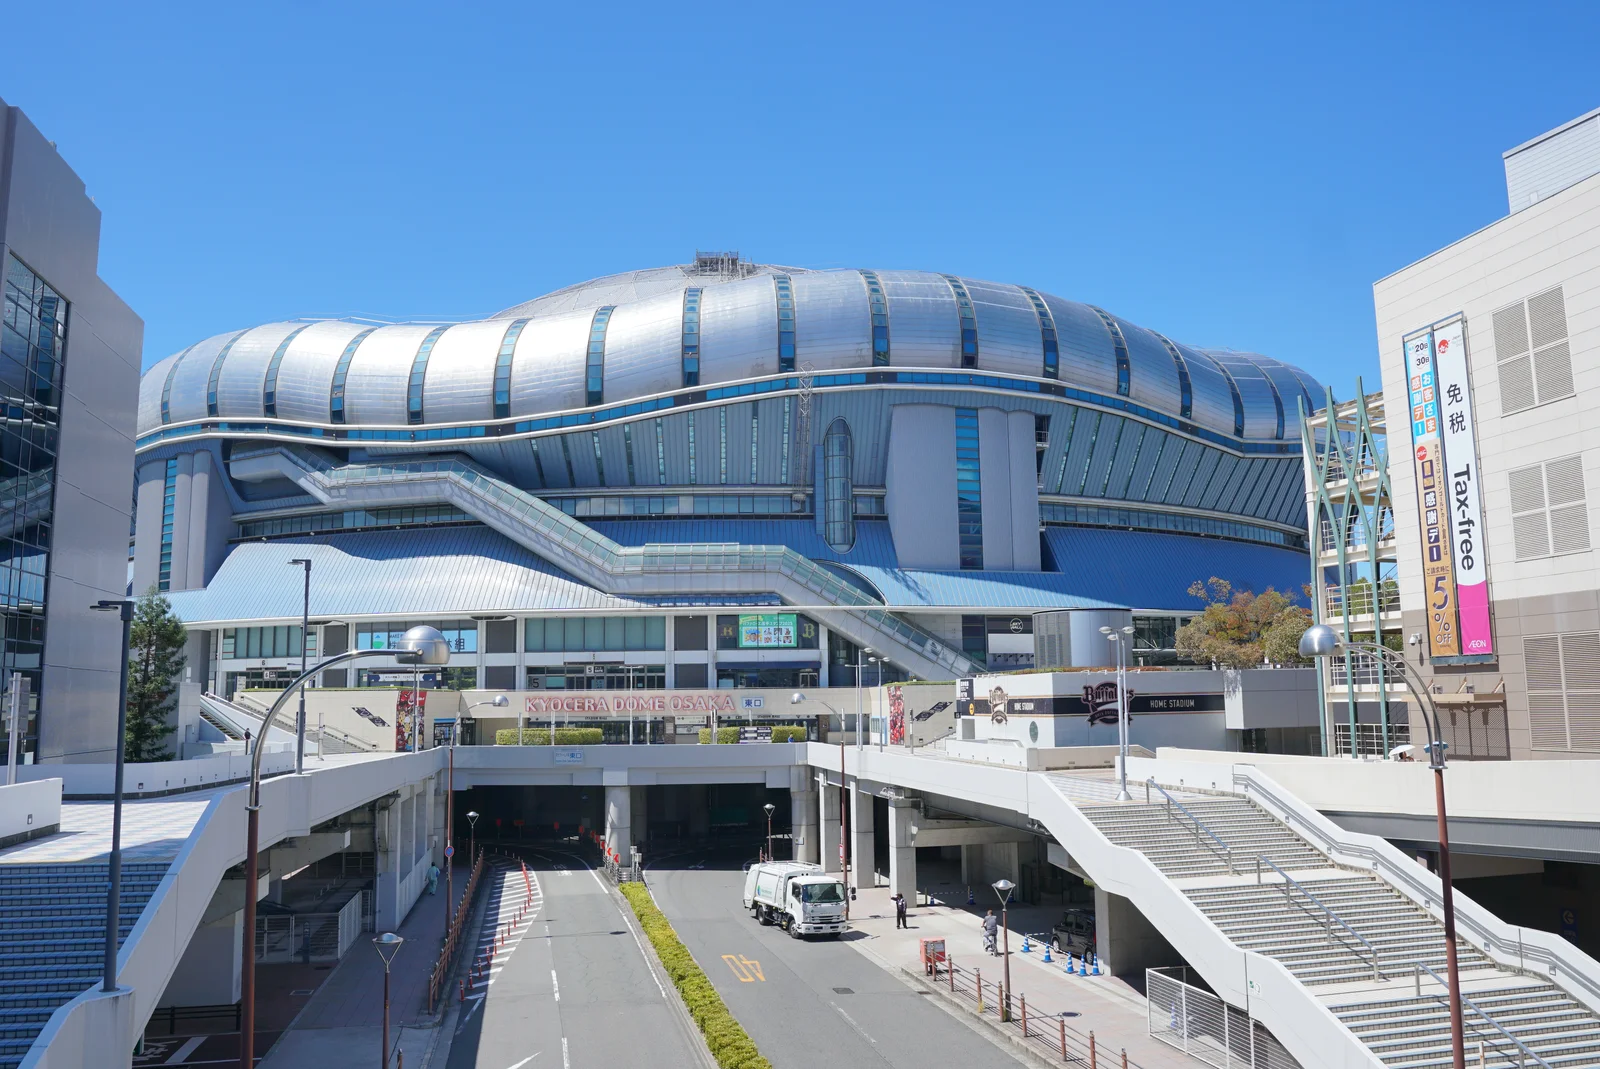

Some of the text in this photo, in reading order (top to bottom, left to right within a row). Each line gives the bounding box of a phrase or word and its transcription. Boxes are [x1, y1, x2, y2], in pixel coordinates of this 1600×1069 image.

[1411, 376, 1425, 435] 感謝デー
[1422, 373, 1436, 432] お客さま
[1447, 384, 1466, 434] 免税
[1454, 463, 1475, 570] Tax-free
[1436, 633, 1452, 645] OFF
[532, 678, 539, 688] 5
[525, 695, 736, 712] KYOCERA DOME OSAKA
[744, 699, 762, 708] 東口
[1150, 699, 1195, 708] HOME STADIUM
